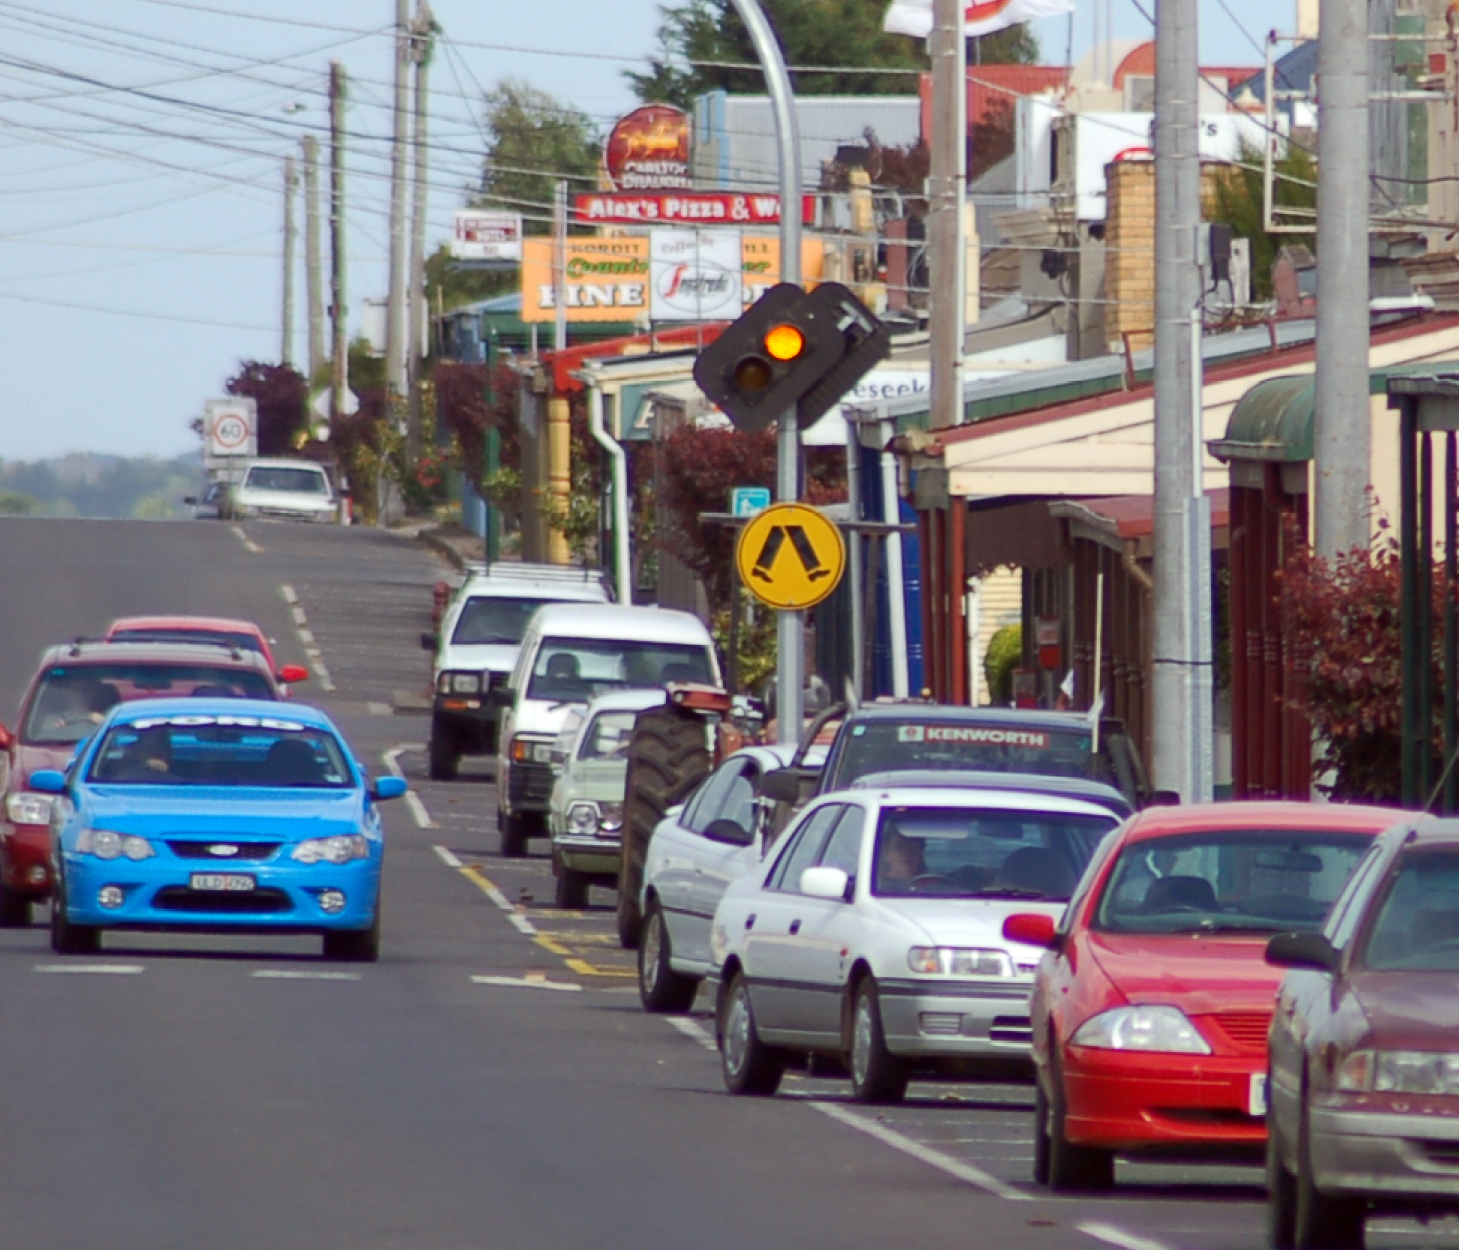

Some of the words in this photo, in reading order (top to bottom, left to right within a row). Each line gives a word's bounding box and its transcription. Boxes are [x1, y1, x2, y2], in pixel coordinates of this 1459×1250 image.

[588, 198, 659, 219] Alex's
[664, 197, 725, 219] Pizza
[731, 198, 751, 220] &
[853, 378, 927, 399] eseek
[220, 423, 242, 439] 60
[131, 715, 305, 732] FORD
[927, 727, 1045, 746] KENWORTH
